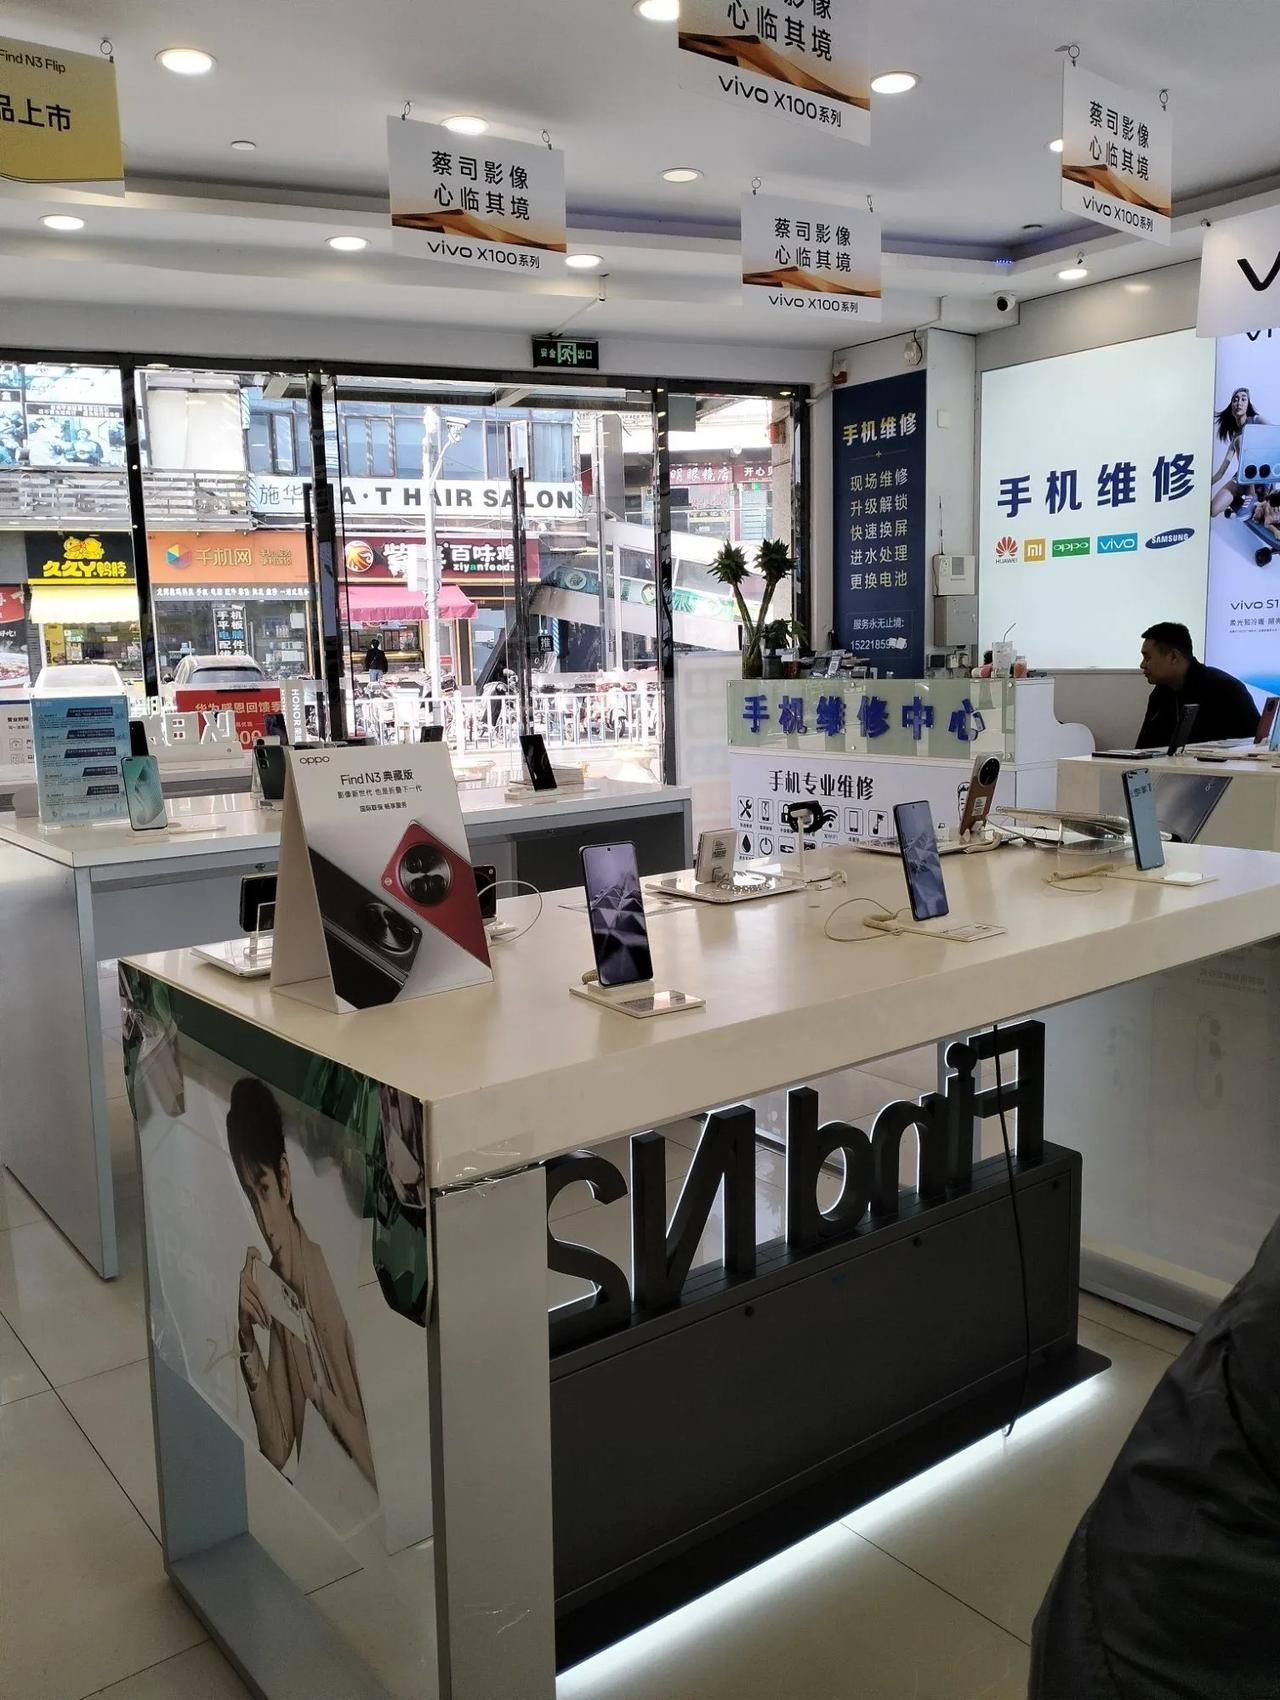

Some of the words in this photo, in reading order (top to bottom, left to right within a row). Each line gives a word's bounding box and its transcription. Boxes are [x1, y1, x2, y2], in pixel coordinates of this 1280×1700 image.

[727, 0, 832, 61] 心临其境
[25, 54, 43, 68] N3
[45, 58, 66, 74] Flip
[718, 75, 769, 104] vivo
[774, 90, 842, 128] X100系列
[1089, 100, 1149, 149] 蔡司影像
[431, 150, 529, 190] 蔡司影像
[1089, 136, 1149, 181] 心临其境
[433, 182, 530, 221] 心临其境
[1082, 196, 1112, 217] vivo
[1114, 206, 1154, 232] X100系列
[774, 217, 851, 247] 蔡司影像
[427, 240, 473, 259] vivo
[477, 247, 540, 269] X100系列
[774, 244, 852, 273] 心临其境
[768, 293, 805, 308] vivo
[808, 297, 859, 314] X100系列
[540, 348, 556, 359] 安全
[577, 349, 593, 360] 出口
[842, 412, 918, 446] 手机维修
[850, 467, 908, 492] 现场维修
[997, 453, 1195, 518] 手机维修
[850, 493, 908, 517] 升级解锁
[850, 519, 908, 542] 快速换屏
[1099, 538, 1135, 550] vivo
[1151, 533, 1190, 544] SAMSUNG
[195, 548, 252, 566] 千机网
[850, 544, 908, 566] 进水处理
[850, 570, 908, 591] 更换电池
[217, 611, 243, 620] 手机
[1230, 600, 1263, 610] vivo
[217, 620, 244, 630] 平板
[218, 630, 244, 640] 电脑
[219, 640, 245, 650] 配件
[291, 688, 302, 727] HONOR
[742, 695, 986, 742] 手机维修中心
[299, 755, 330, 765] oppo
[340, 774, 364, 785] Find
[365, 771, 382, 784] N3
[383, 768, 414, 782] 典藏版
[768, 770, 874, 801] 手机专业维修
[337, 789, 374, 799] 影像新世代
[375, 784, 422, 796] 也是折叠下一代
